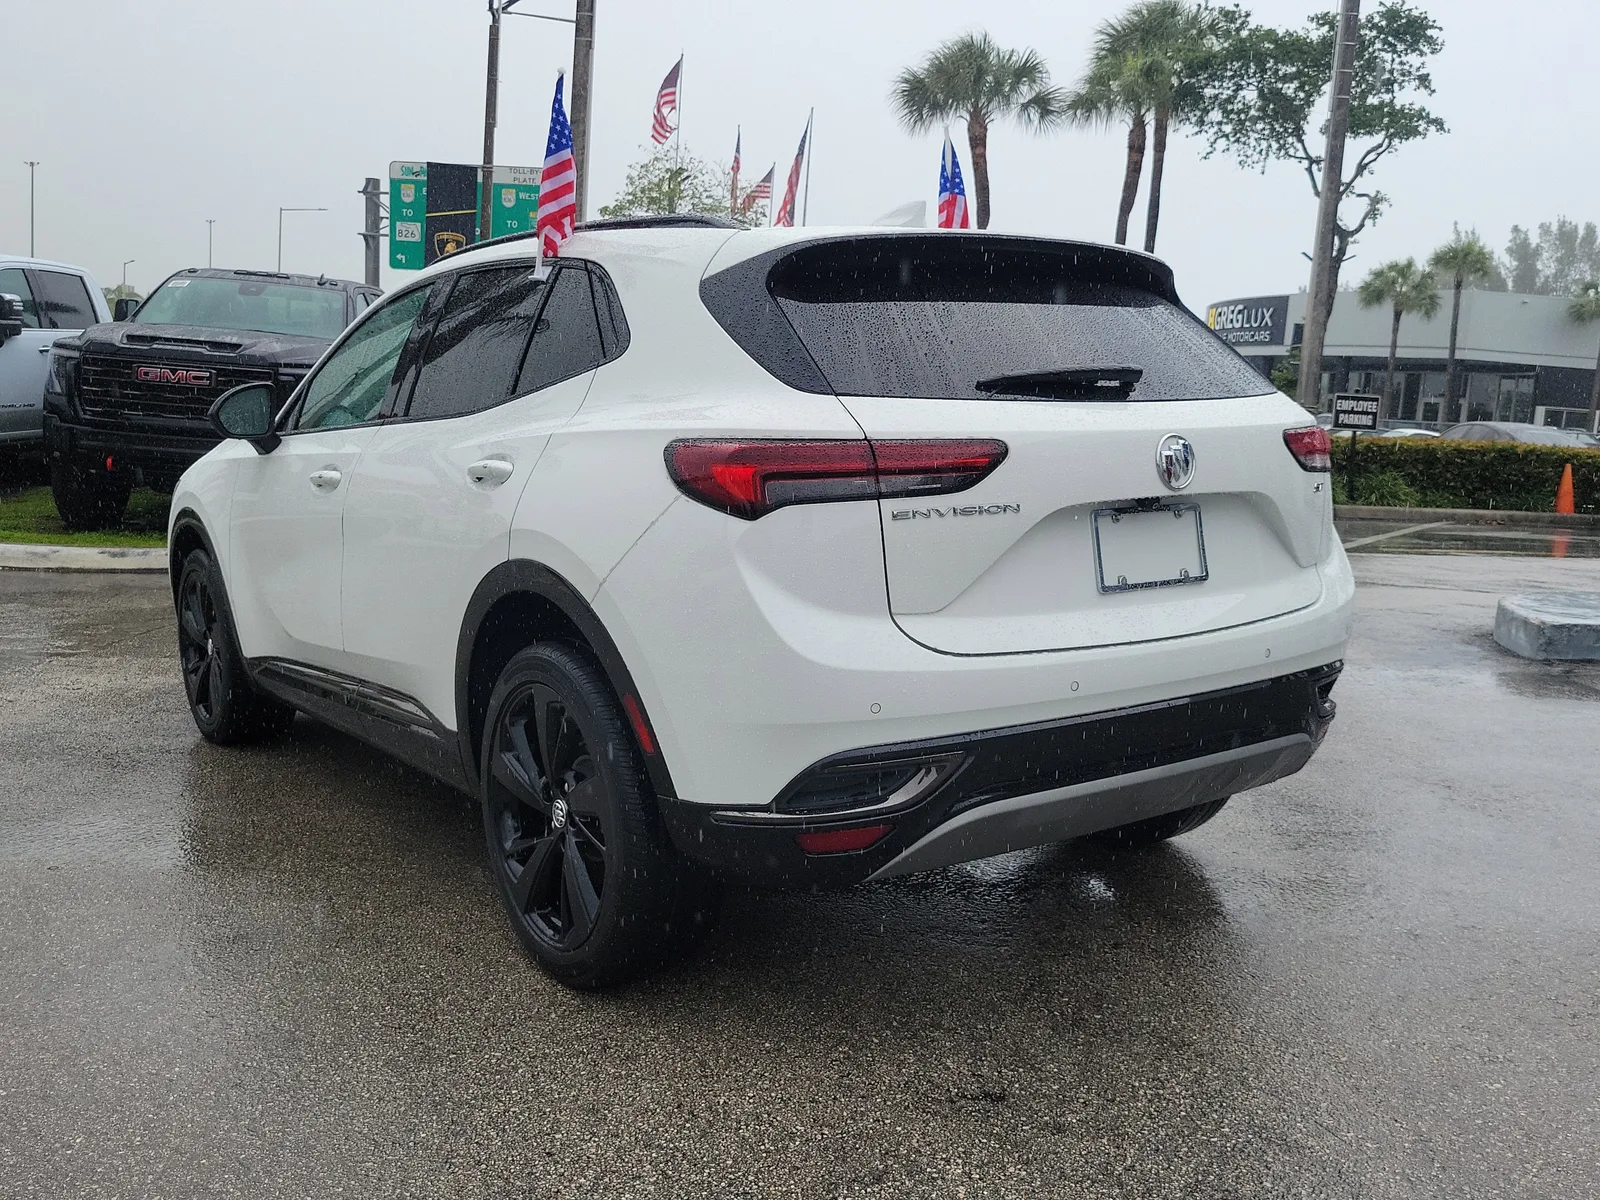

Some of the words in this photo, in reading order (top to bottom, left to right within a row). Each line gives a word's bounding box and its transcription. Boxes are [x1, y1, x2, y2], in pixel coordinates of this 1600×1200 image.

[402, 209, 413, 217] TO
[506, 220, 518, 229] TO
[397, 229, 416, 239] 826
[137, 366, 210, 385] GMC
[1336, 400, 1378, 413] EMPLOYEE
[1338, 413, 1373, 426] PARKING
[892, 503, 1020, 521] ENVISION
